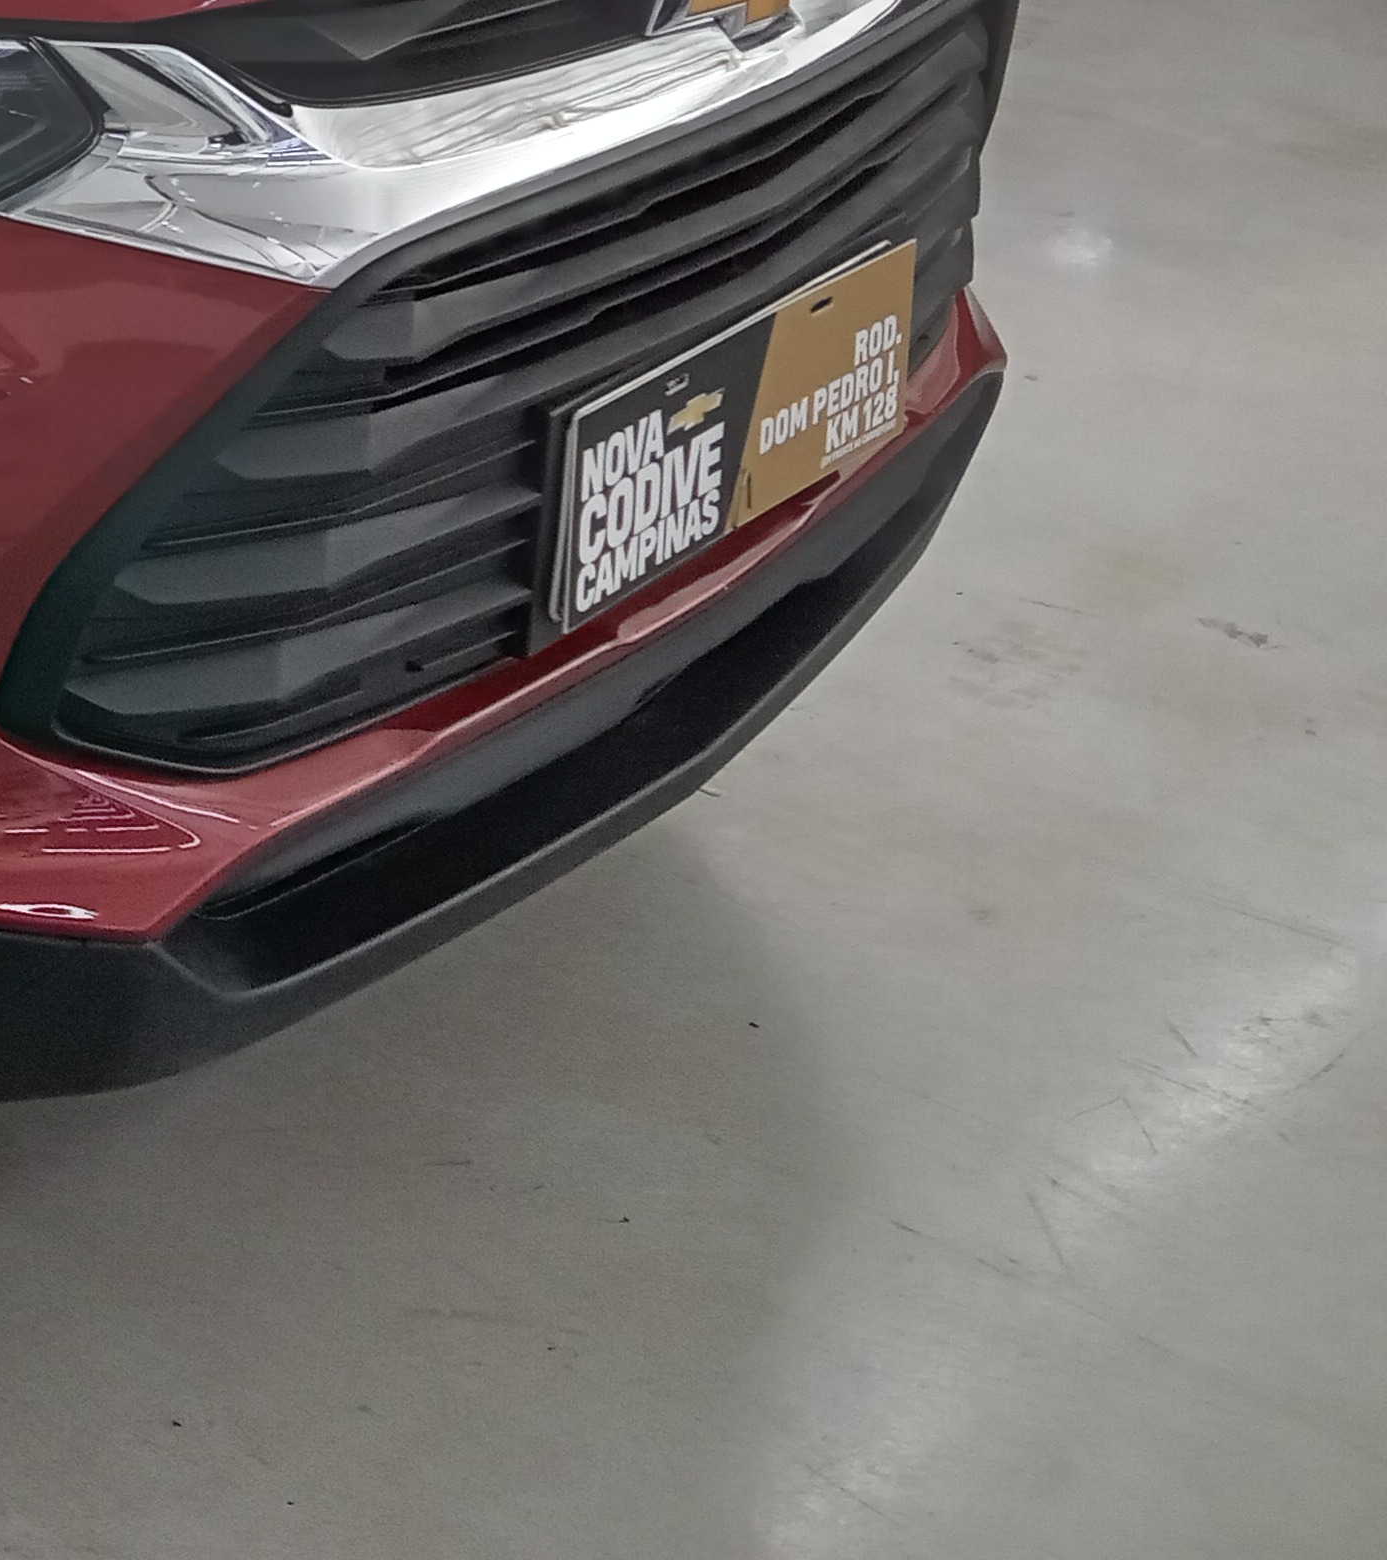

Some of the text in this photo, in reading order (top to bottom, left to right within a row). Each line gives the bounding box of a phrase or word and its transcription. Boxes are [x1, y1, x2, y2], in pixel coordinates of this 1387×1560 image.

[854, 314, 902, 366] ROD.
[759, 396, 809, 455] DOM
[812, 357, 883, 425] PEDRO
[826, 404, 859, 453] KM
[863, 385, 897, 431] 128
[578, 421, 725, 565] CODIVE
[581, 409, 664, 502] NOVA
[576, 488, 720, 613] CAMPINAS
